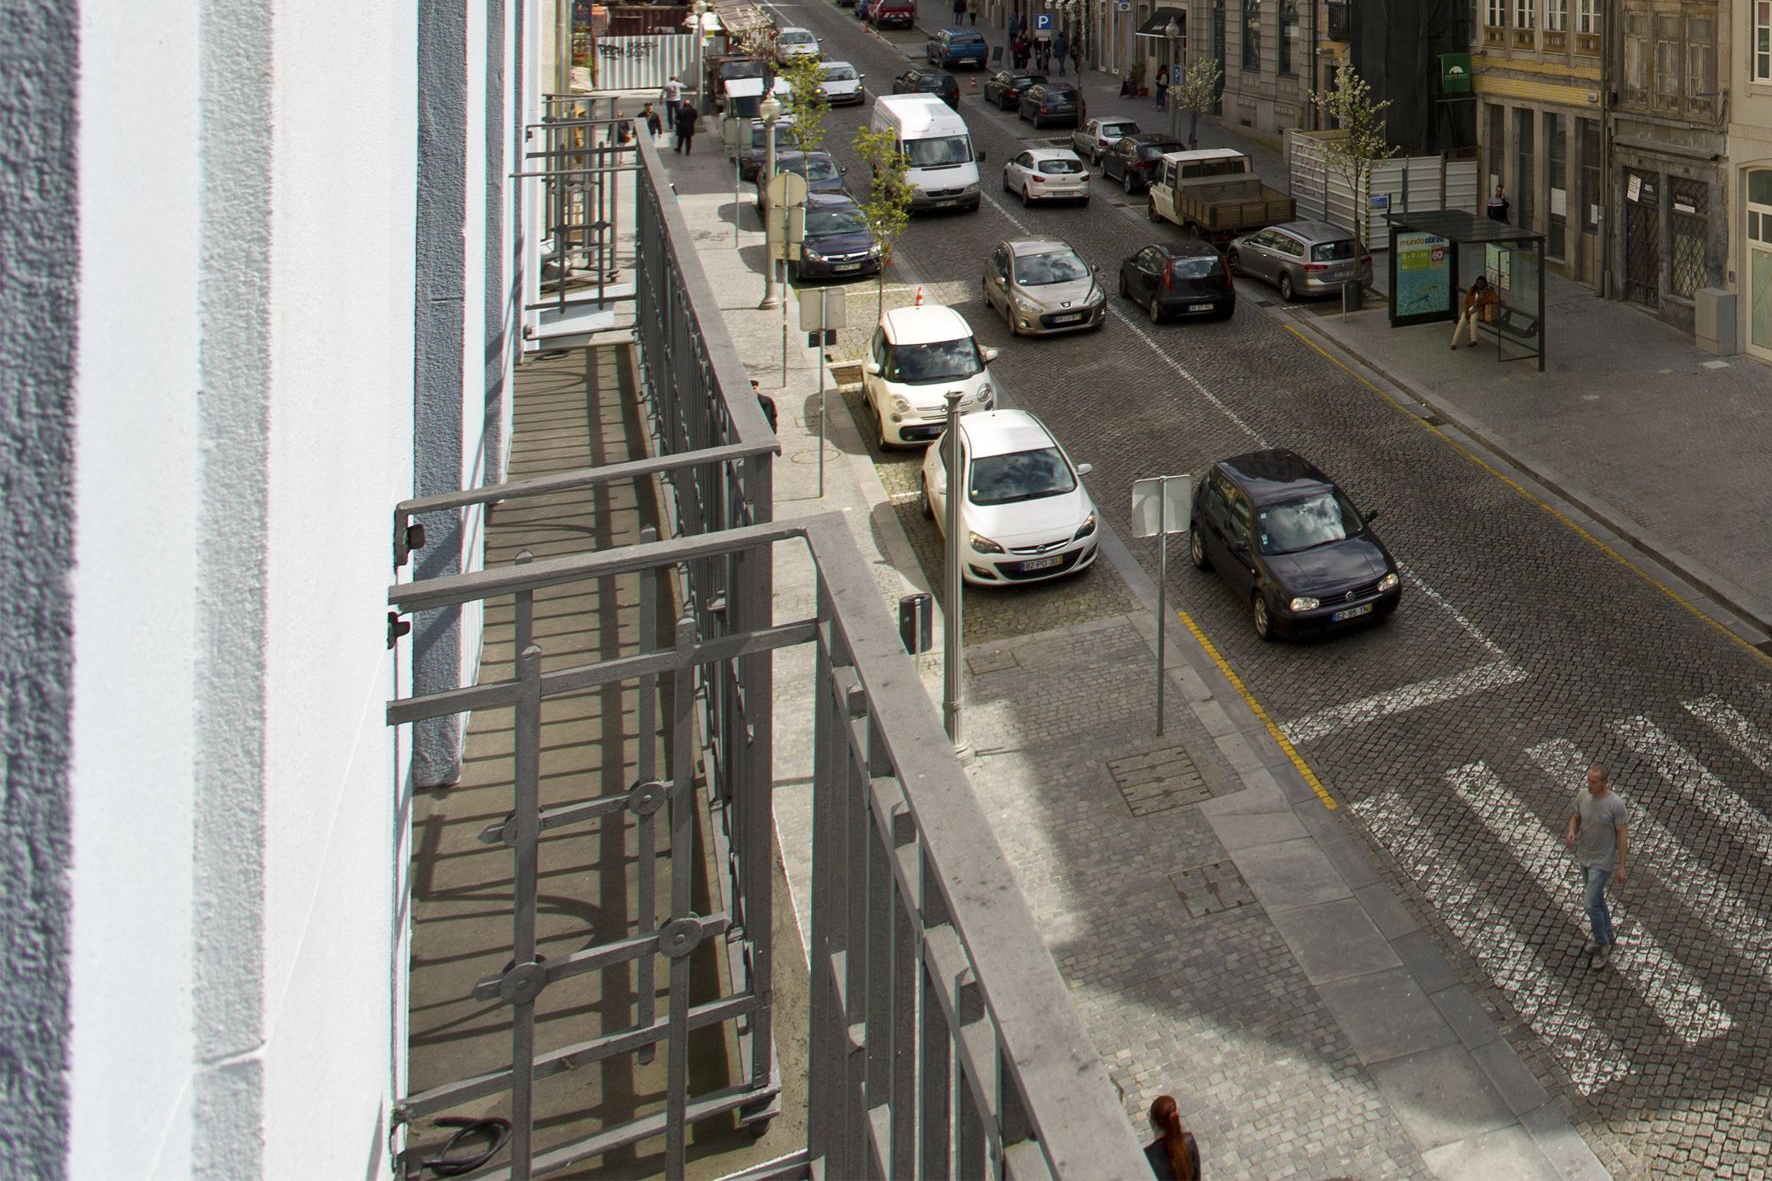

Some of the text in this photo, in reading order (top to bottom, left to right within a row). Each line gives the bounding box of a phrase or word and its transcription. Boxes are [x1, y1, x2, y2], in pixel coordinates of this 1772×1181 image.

[1038, 15, 1049, 29] P
[1400, 237, 1425, 247] mundo
[1432, 250, 1443, 260] 60
